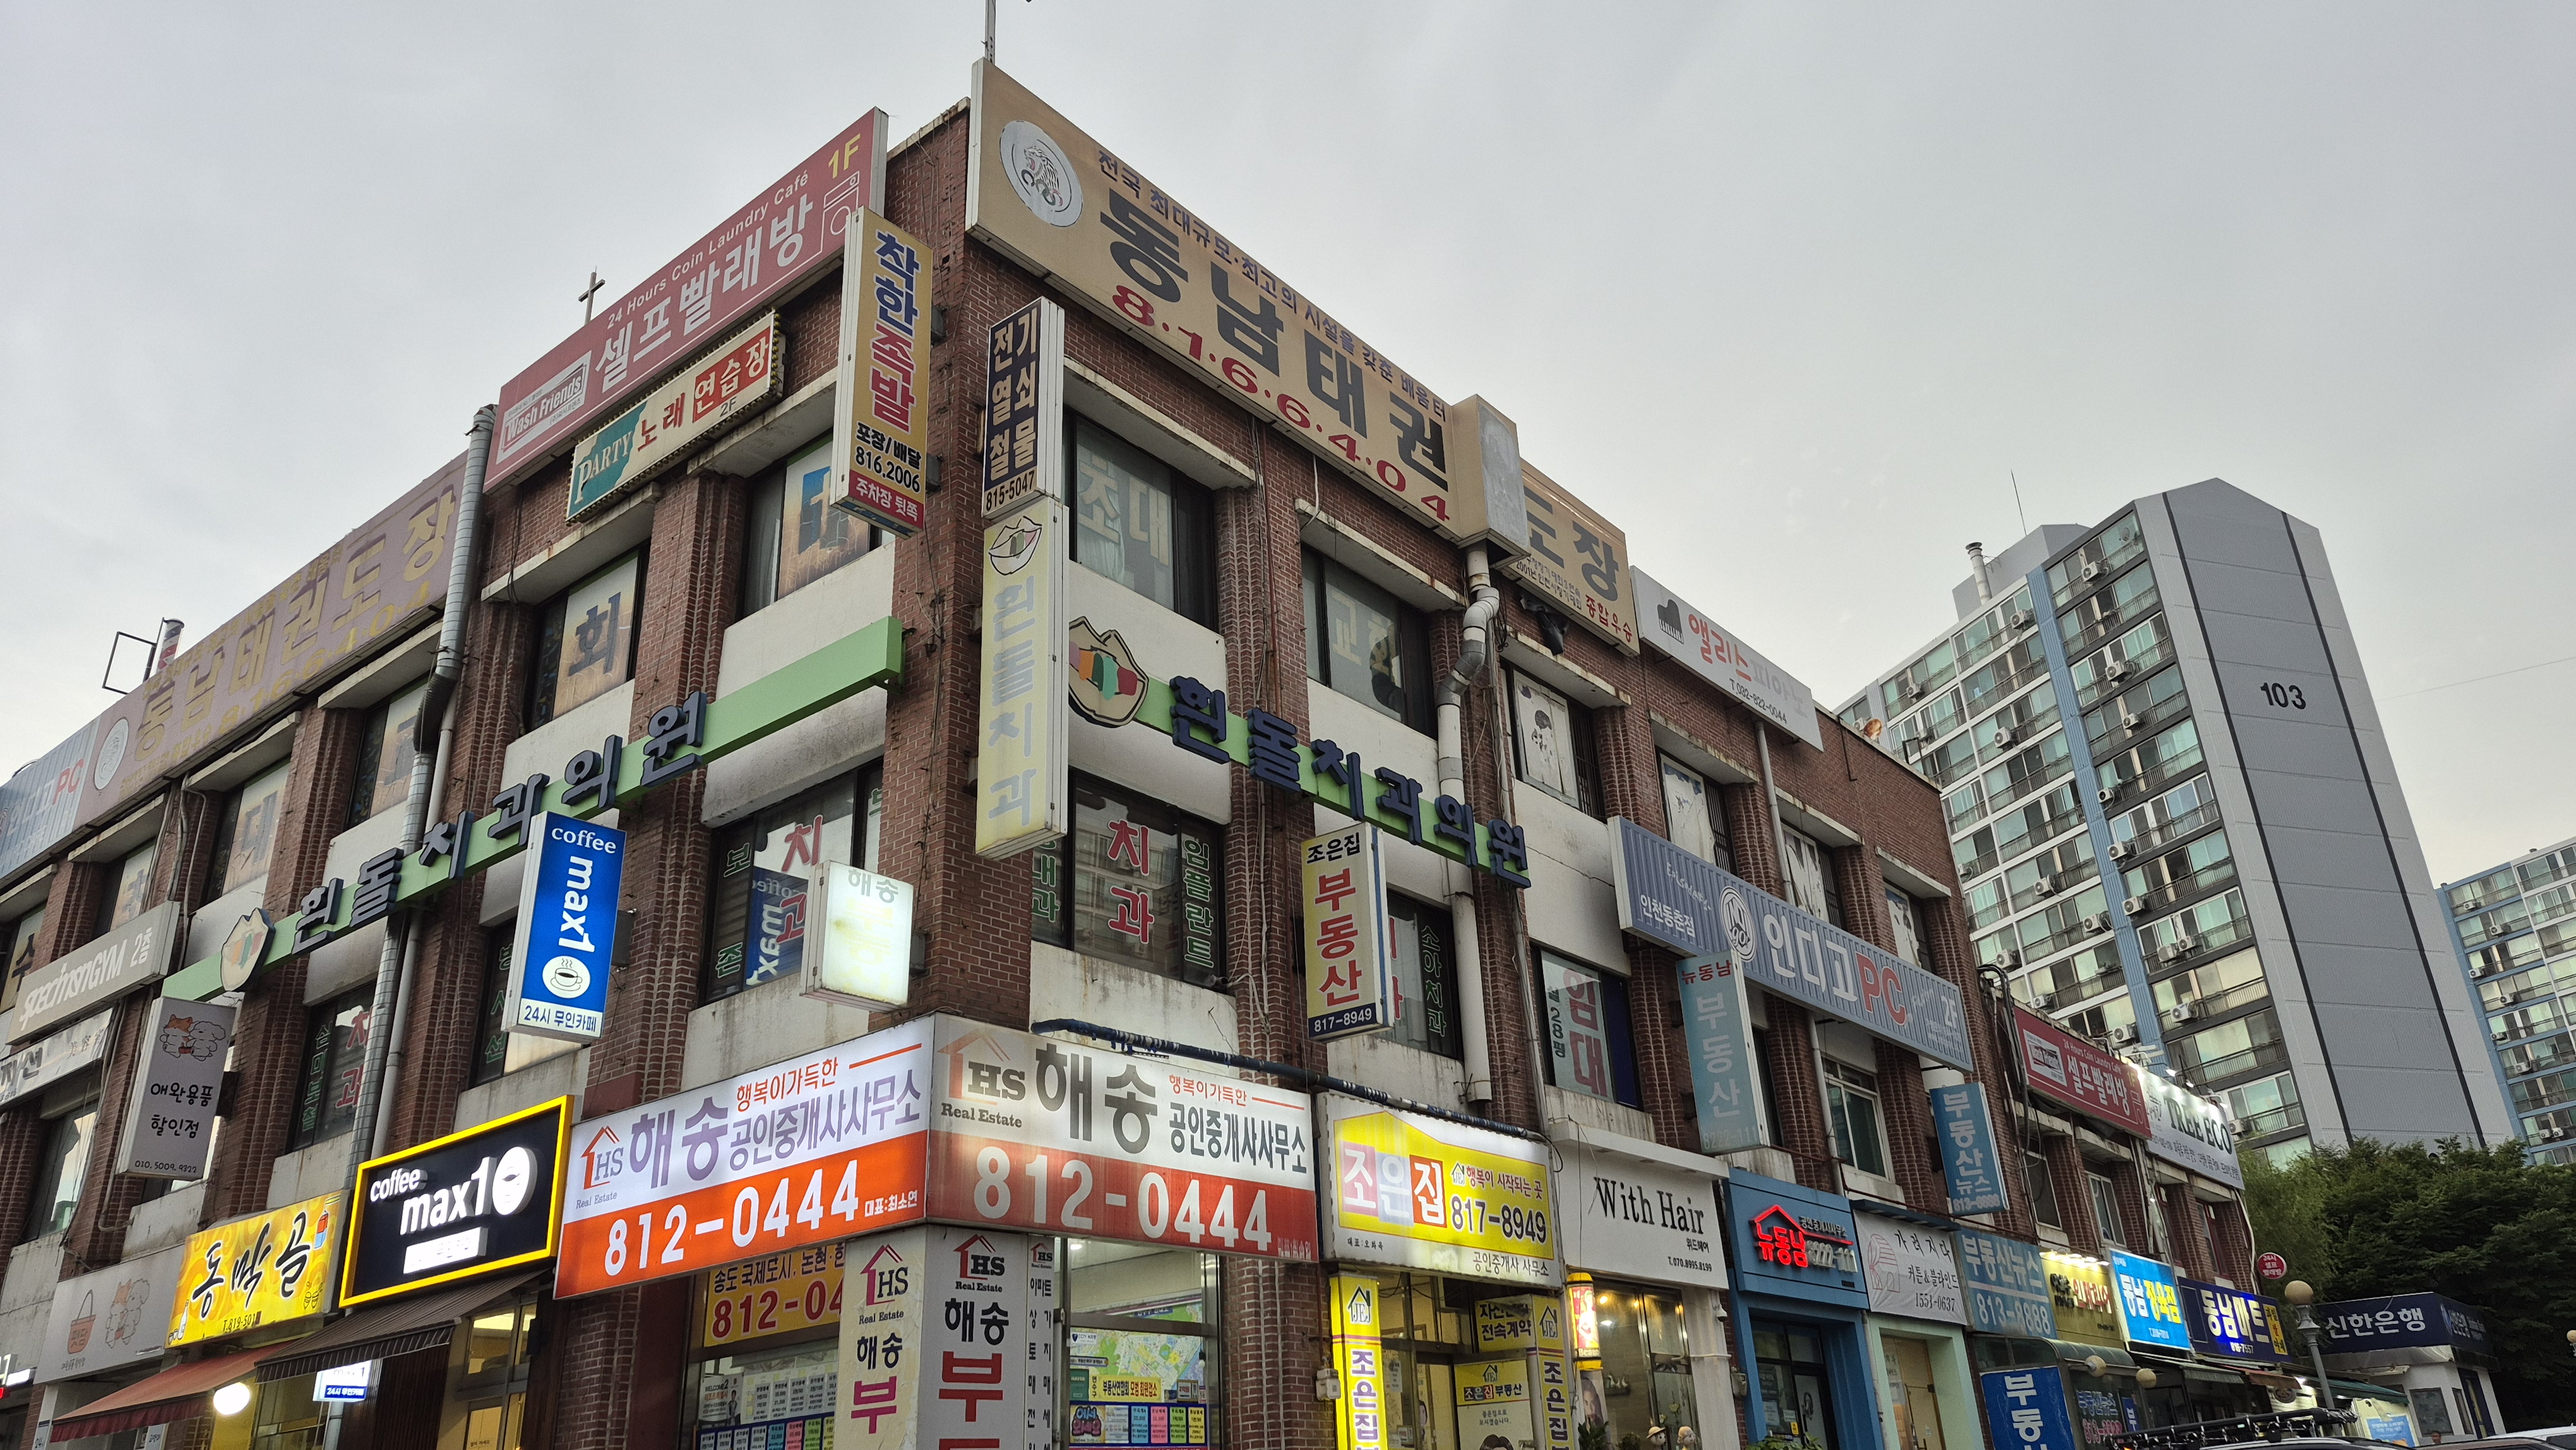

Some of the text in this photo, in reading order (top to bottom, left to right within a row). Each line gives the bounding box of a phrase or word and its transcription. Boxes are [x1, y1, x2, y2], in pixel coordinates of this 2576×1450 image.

[828, 133, 860, 180] 1F
[607, 169, 810, 329] 24 Hours Coin Laundry Café
[594, 193, 814, 393] 셀프빨래방
[1099, 149, 1141, 199] 전국
[1305, 305, 1354, 355] 시설을
[1362, 344, 1393, 384] 갖춘
[1401, 374, 1446, 422] 배움터
[505, 405, 538, 442] Wash
[538, 375, 582, 419] Friends
[719, 399, 737, 419] 2F
[573, 428, 634, 505] PARTY
[855, 422, 922, 471] 포장/배달
[855, 446, 922, 494] 816.2006
[855, 475, 920, 523] 주차장 뒷쪽
[985, 471, 1036, 512] 815-5047
[134, 484, 456, 762] 동남태권도장
[1585, 594, 1633, 643] 종합우승
[1729, 677, 1788, 724] T.032-822-0044
[2259, 681, 2307, 711] 103
[551, 825, 618, 854] coffee
[1307, 836, 1361, 864] 조은집
[848, 868, 899, 904] 해송
[1106, 818, 1155, 944] 치과
[1183, 838, 1215, 969] 임플란트
[1640, 894, 1696, 938] 인천동춘점
[129, 926, 153, 968] 2층
[1314, 868, 1363, 1008] 부동산
[1421, 925, 1447, 1037] 소아치과
[1681, 959, 1732, 985] 뉴동남
[524, 1004, 597, 1034] 24시 무인카페
[1313, 1007, 1373, 1033] 817-8949
[1562, 967, 1609, 1098] 임대
[1941, 995, 1959, 1030] 2F
[1697, 992, 1740, 1118] 부동산
[2070, 1043, 2084, 1058] Hours
[151, 1081, 214, 1108] 애완용품
[736, 1056, 839, 1113] 행복이가득한
[967, 1060, 1027, 1102] HS
[1036, 1042, 1157, 1154] 해송
[1168, 1073, 1248, 1107] 행복이가득한
[2067, 1055, 2130, 1116] 셀프빨래방
[151, 1113, 200, 1137] 할인점
[729, 1068, 922, 1172] 공인중개사사무소
[941, 1102, 1023, 1129] Real Estate
[1942, 1091, 1984, 1178] 부동산
[629, 1096, 729, 1190] 해송
[1168, 1101, 1307, 1175] 공인중개사사무소
[2202, 1118, 2233, 1155] ECO
[370, 1166, 425, 1203] coffee
[594, 1147, 624, 1182] HS
[1340, 1141, 1447, 1227] 조은집
[1466, 1164, 1543, 1200] 행복이 시작되는 곳
[576, 1191, 618, 1210] Real Estate
[864, 1188, 918, 1218] 대표:최소연
[973, 1145, 1273, 1252] 812-0444
[1592, 1174, 1705, 1236] With Hair
[1955, 1176, 1992, 1196] 뉴스
[604, 1159, 860, 1277] 812-0444
[1450, 1194, 1547, 1243] 817-8949
[1037, 1250, 1054, 1263] HS
[1472, 1250, 1550, 1278] 공인중개사 사무소
[1686, 1237, 1710, 1254] 위드헤어
[1753, 1221, 1809, 1268] 뉴동남
[1894, 1229, 1952, 1264] 가려지다
[1962, 1234, 2043, 1289] 부동산뉴스
[192, 1211, 311, 1320] 동막골
[714, 1266, 738, 1294] 송도
[876, 1266, 909, 1299] HS
[971, 1254, 1005, 1276] HS
[1908, 1264, 1959, 1289] 커튼&블라인드
[955, 1281, 1003, 1294] Real Estate
[1030, 1277, 1052, 1297] 아파트
[1915, 1292, 1955, 1313] 1551-0637
[223, 1310, 262, 1332] T.819-501
[858, 1309, 905, 1325] Real Estate
[944, 1297, 1010, 1346] 해송
[1029, 1309, 1052, 1330] 상가
[1481, 1320, 1532, 1342] 전속계약
[1976, 1292, 2052, 1336] 813-8888
[2200, 1289, 2271, 1344] 동남마트
[2325, 1307, 2427, 1339] 신한은행
[857, 1330, 903, 1370] 해송
[1028, 1342, 1052, 1362] 토지
[1028, 1375, 1051, 1395] 매매
[1027, 1408, 1051, 1429] 전세
[2003, 1373, 2048, 1450] 부동
